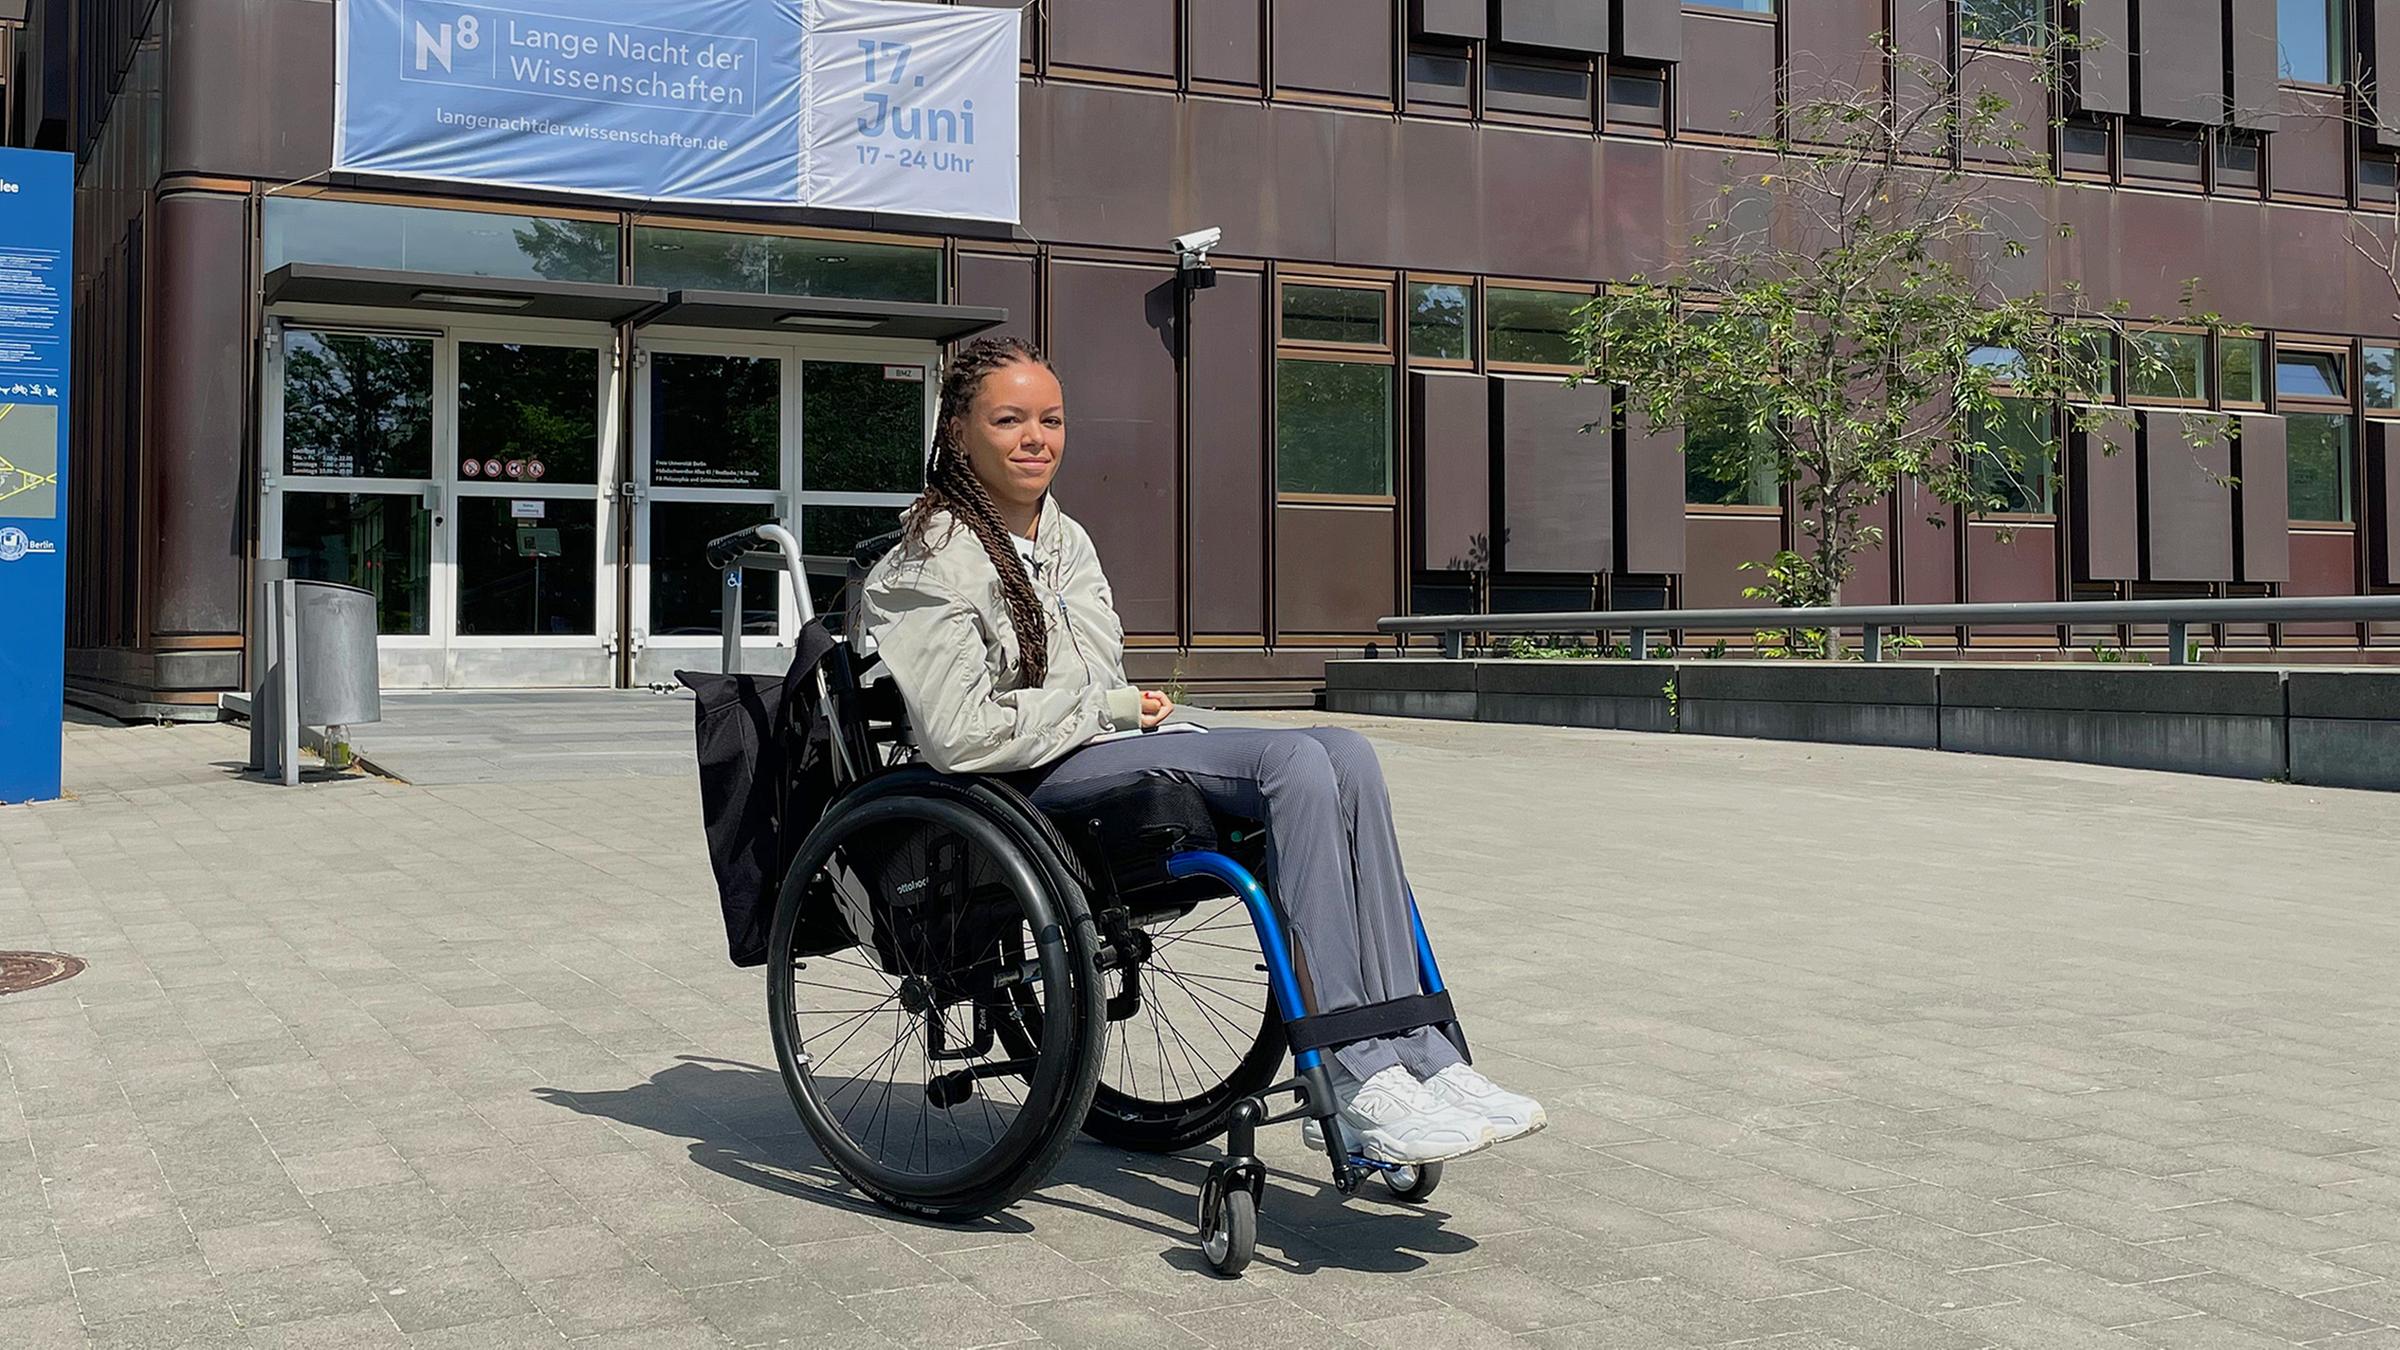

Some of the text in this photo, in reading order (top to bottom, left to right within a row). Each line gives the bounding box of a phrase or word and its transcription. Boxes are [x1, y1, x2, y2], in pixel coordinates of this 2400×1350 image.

[510, 20, 744, 71] Lange Nacht der
[858, 39, 924, 87] 17.
[510, 56, 743, 105] Wissenschaften
[436, 108, 728, 151] langenachtderwissenschaften.de
[857, 93, 974, 144] Juni
[933, 151, 974, 173] Uhr
[29, 540, 54, 549] Berlin
